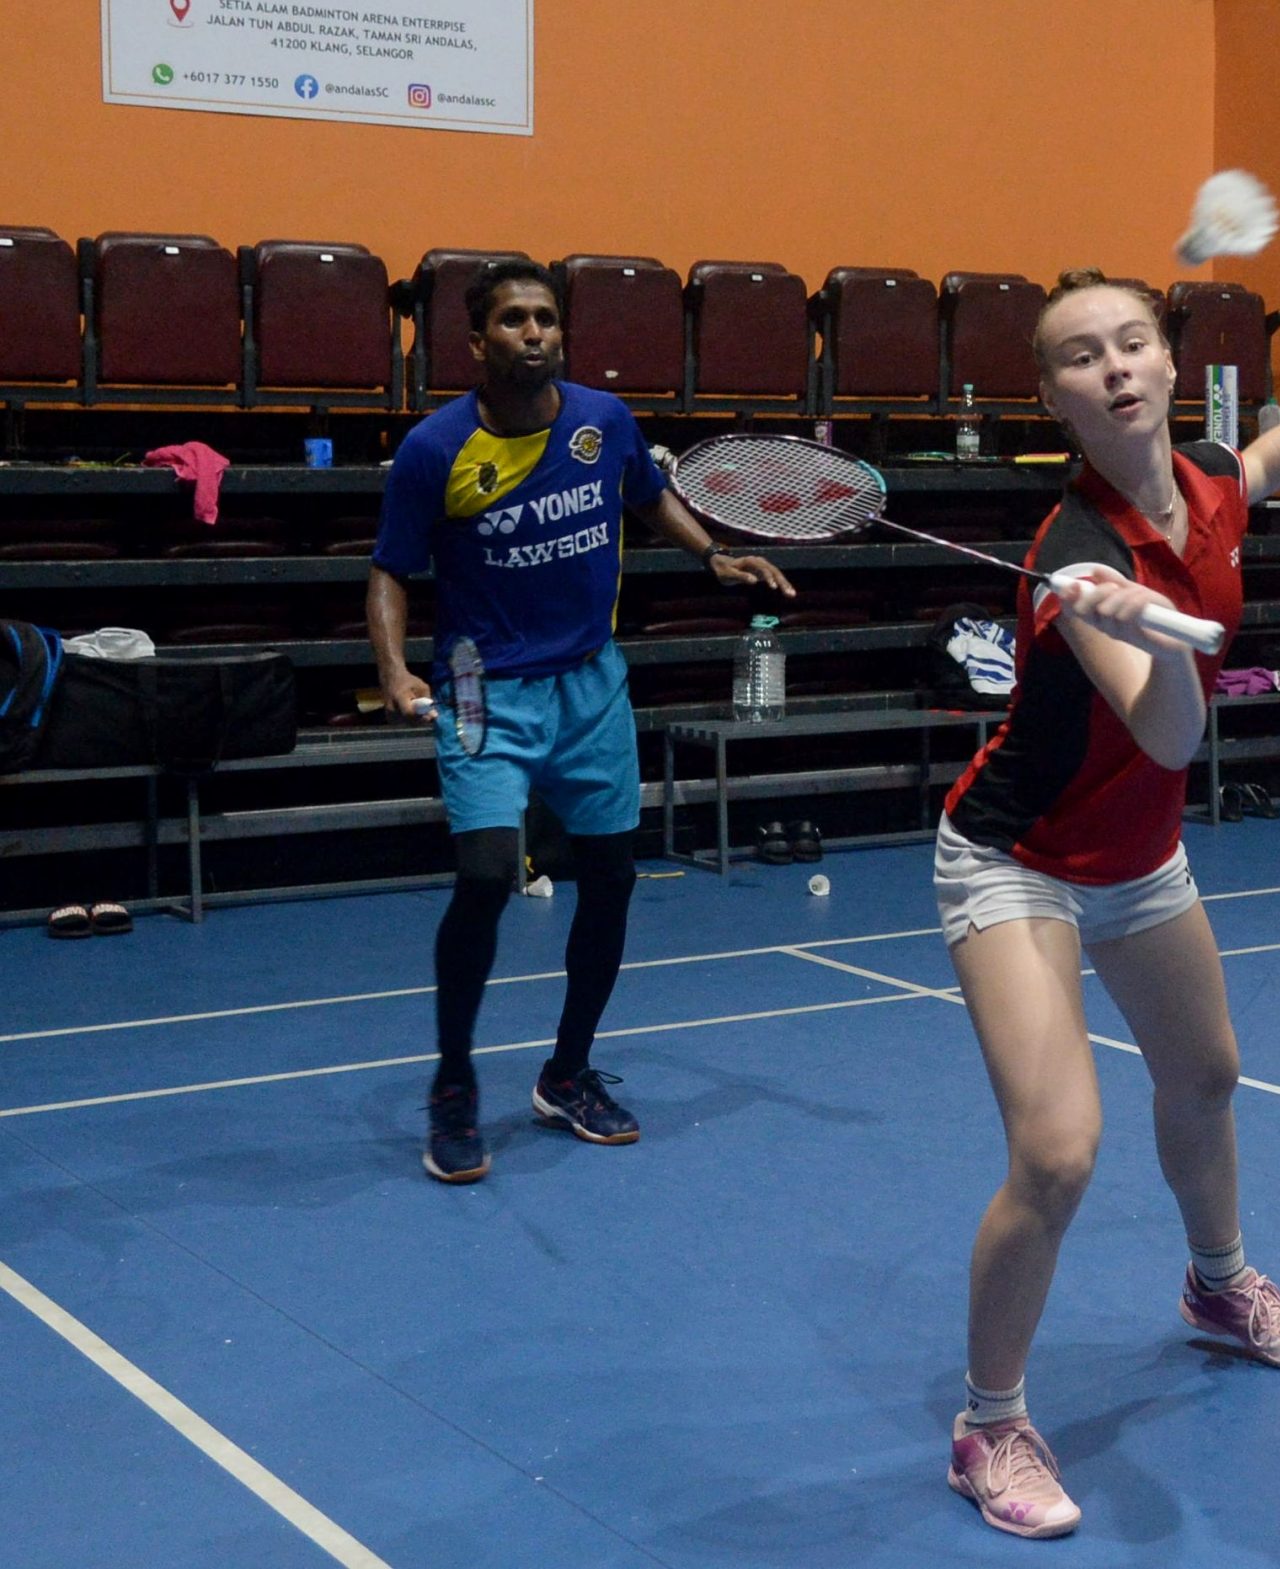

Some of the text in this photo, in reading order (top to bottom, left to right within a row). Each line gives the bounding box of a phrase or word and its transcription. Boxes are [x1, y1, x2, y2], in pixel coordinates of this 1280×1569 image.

[206, 14, 477, 51] JALAN TUN ABDUL RAZAK, TAMAN SRI ANDALAS,
[219, 0, 466, 33] SETIA ALAM BADMINTON ARENA ENTERRPISE
[270, 38, 414, 60] 41200 KLANG, SELANGOR
[183, 71, 279, 89] +6017 377 1550
[325, 83, 389, 98] @andalasSC
[529, 480, 604, 525] YONEX
[483, 522, 610, 568] LAWSON
